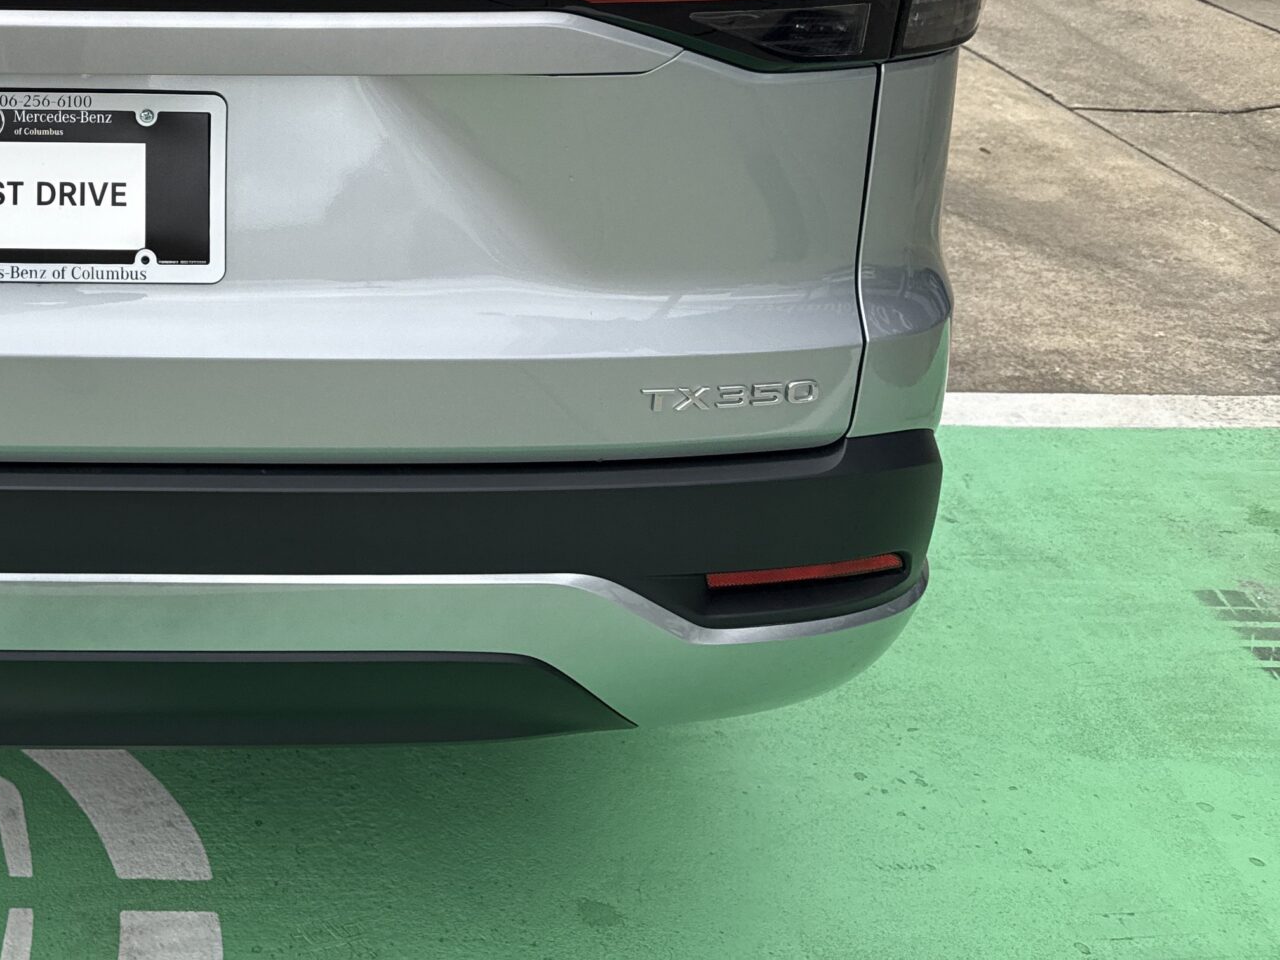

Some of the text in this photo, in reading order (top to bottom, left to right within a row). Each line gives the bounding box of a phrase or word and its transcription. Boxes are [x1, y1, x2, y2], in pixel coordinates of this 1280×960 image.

[13, 110, 112, 123] Mercedes-Benz
[14, 127, 64, 136] of Columbus
[36, 181, 127, 207] DRIVE
[52, 266, 66, 280] of
[71, 266, 147, 281] Columbus
